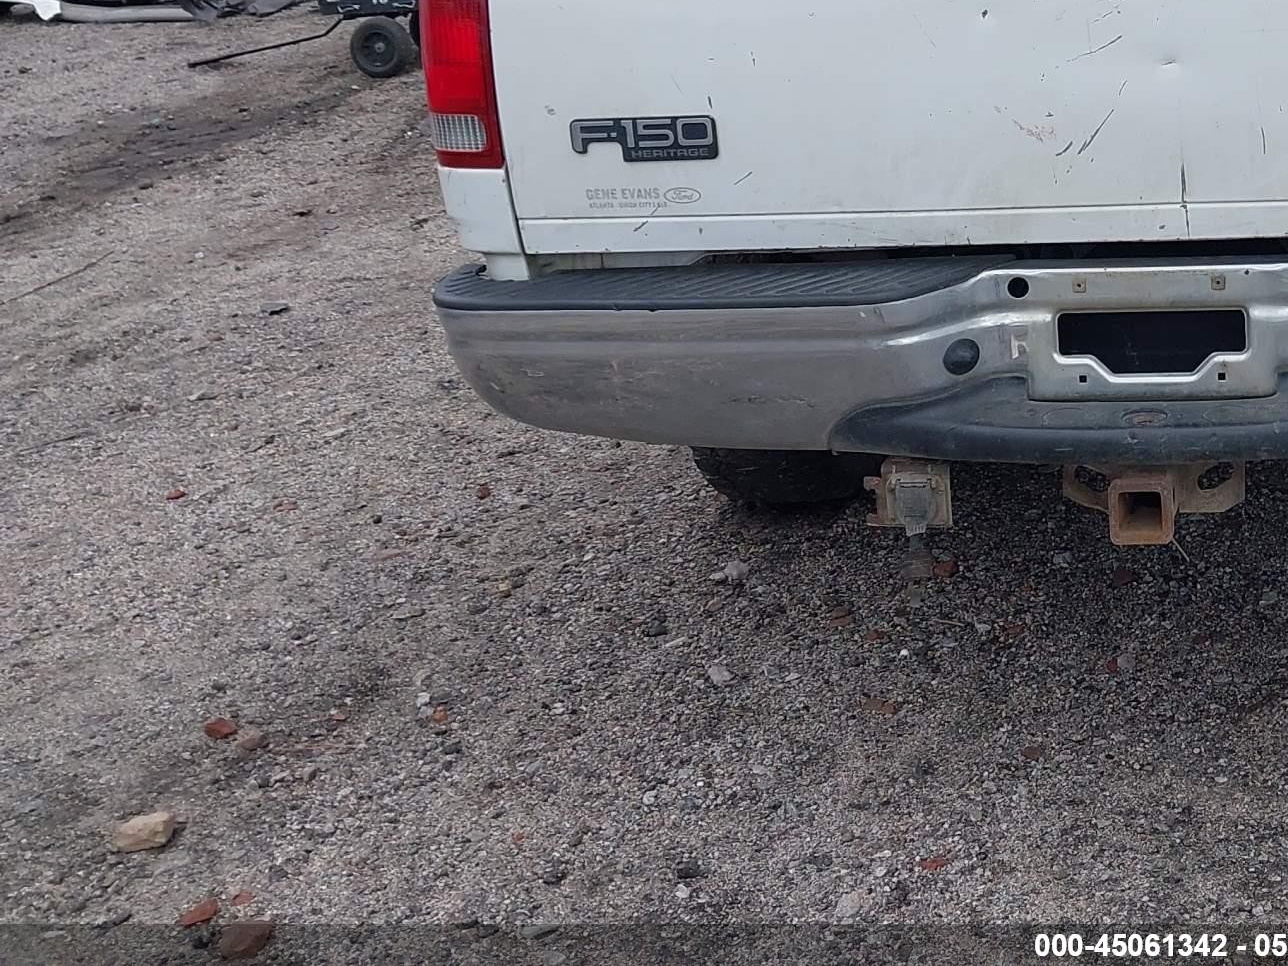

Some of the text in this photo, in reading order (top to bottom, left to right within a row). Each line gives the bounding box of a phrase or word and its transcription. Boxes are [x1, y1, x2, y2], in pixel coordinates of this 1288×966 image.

[631, 147, 710, 159] HERITAGE
[585, 188, 618, 201] GENE
[621, 187, 661, 200] EVANS
